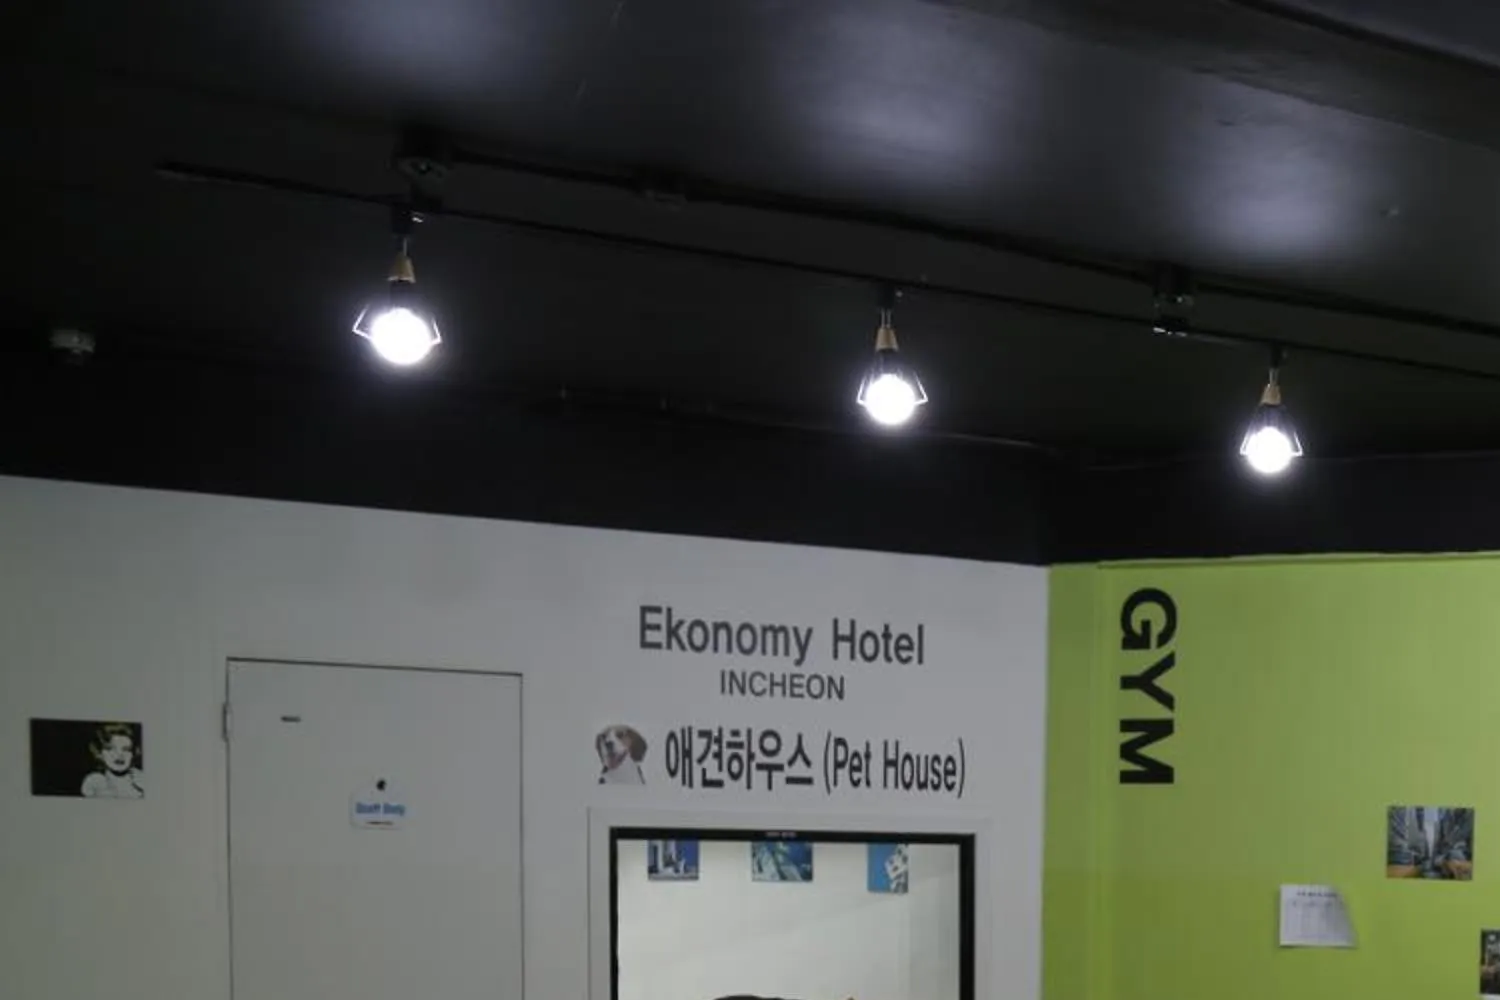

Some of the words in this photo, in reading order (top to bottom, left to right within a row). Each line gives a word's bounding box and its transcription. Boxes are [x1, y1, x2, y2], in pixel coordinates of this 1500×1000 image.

[638, 605, 812, 666] Ekonomy
[832, 618, 925, 665] Hotel
[719, 669, 845, 700] INCHEON
[1119, 587, 1178, 785] GYM
[665, 725, 814, 791] 애견하우스
[823, 732, 872, 794] (Pet
[883, 737, 966, 798] House)
